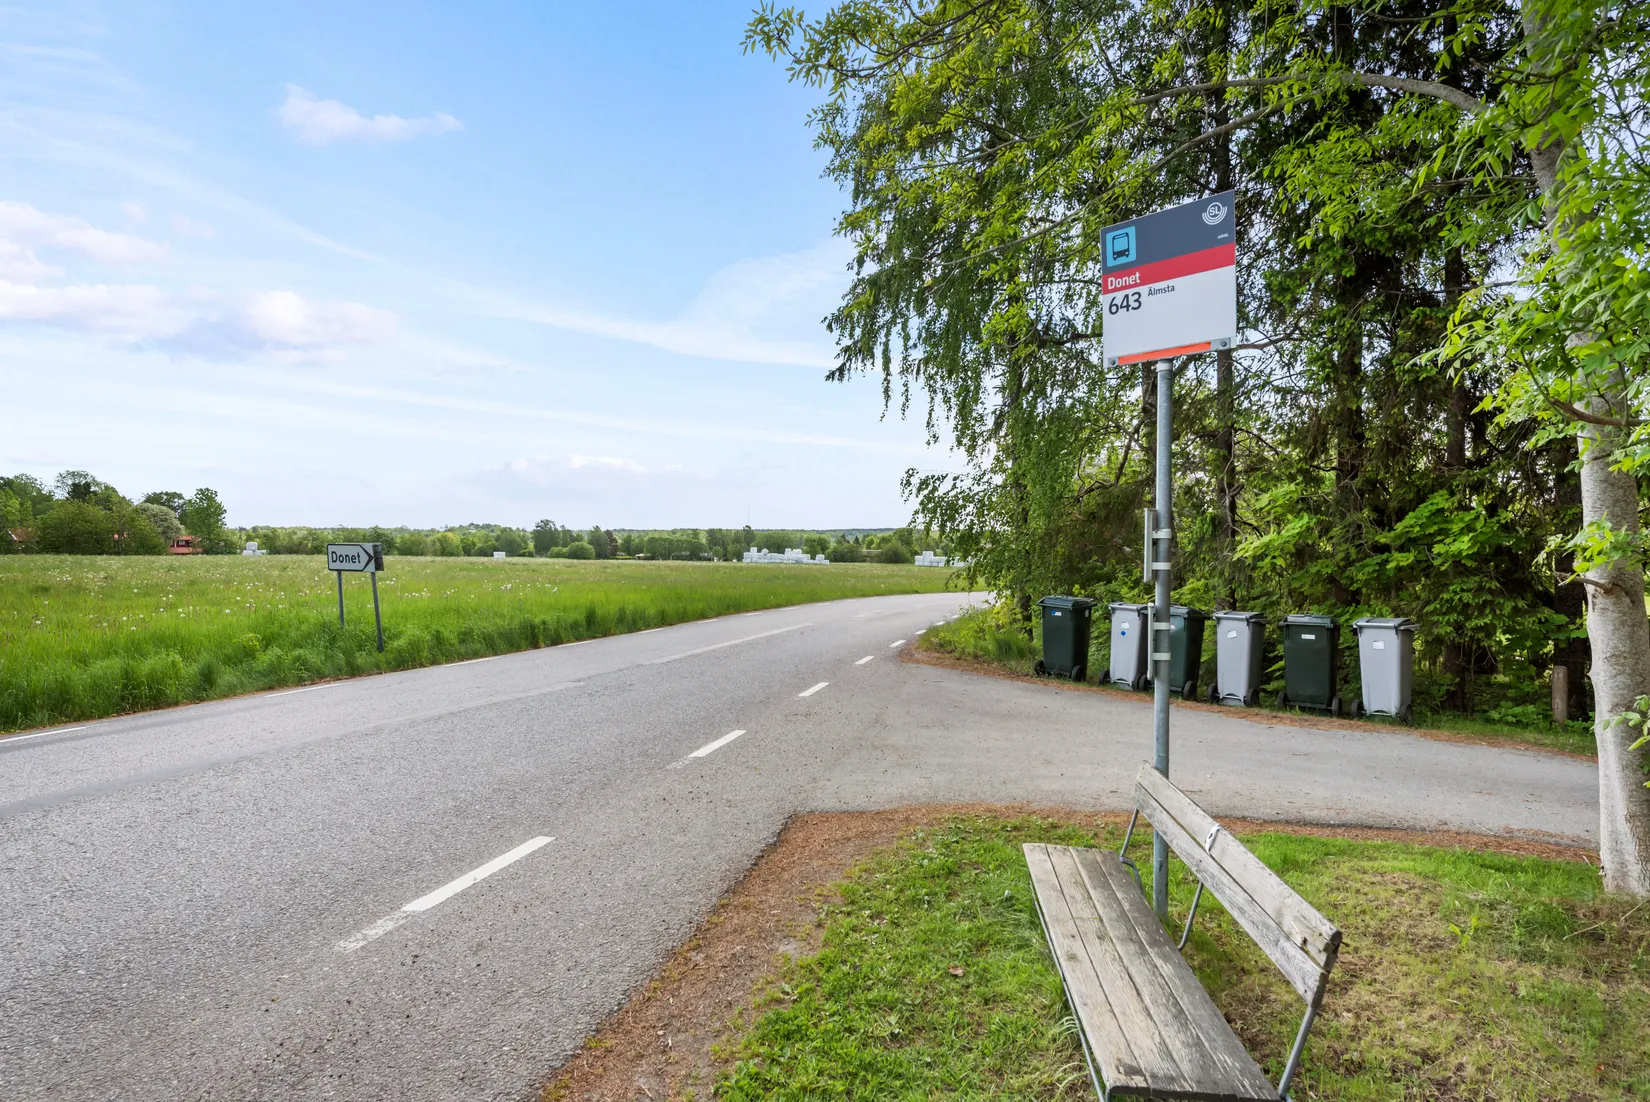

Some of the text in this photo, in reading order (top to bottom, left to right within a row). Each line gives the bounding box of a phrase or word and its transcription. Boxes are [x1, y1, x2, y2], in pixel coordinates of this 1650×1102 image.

[1209, 206, 1221, 216] SL
[1107, 271, 1141, 290] Donet
[1108, 284, 1175, 316] 643 Älmsta
[331, 551, 361, 564] Donet
